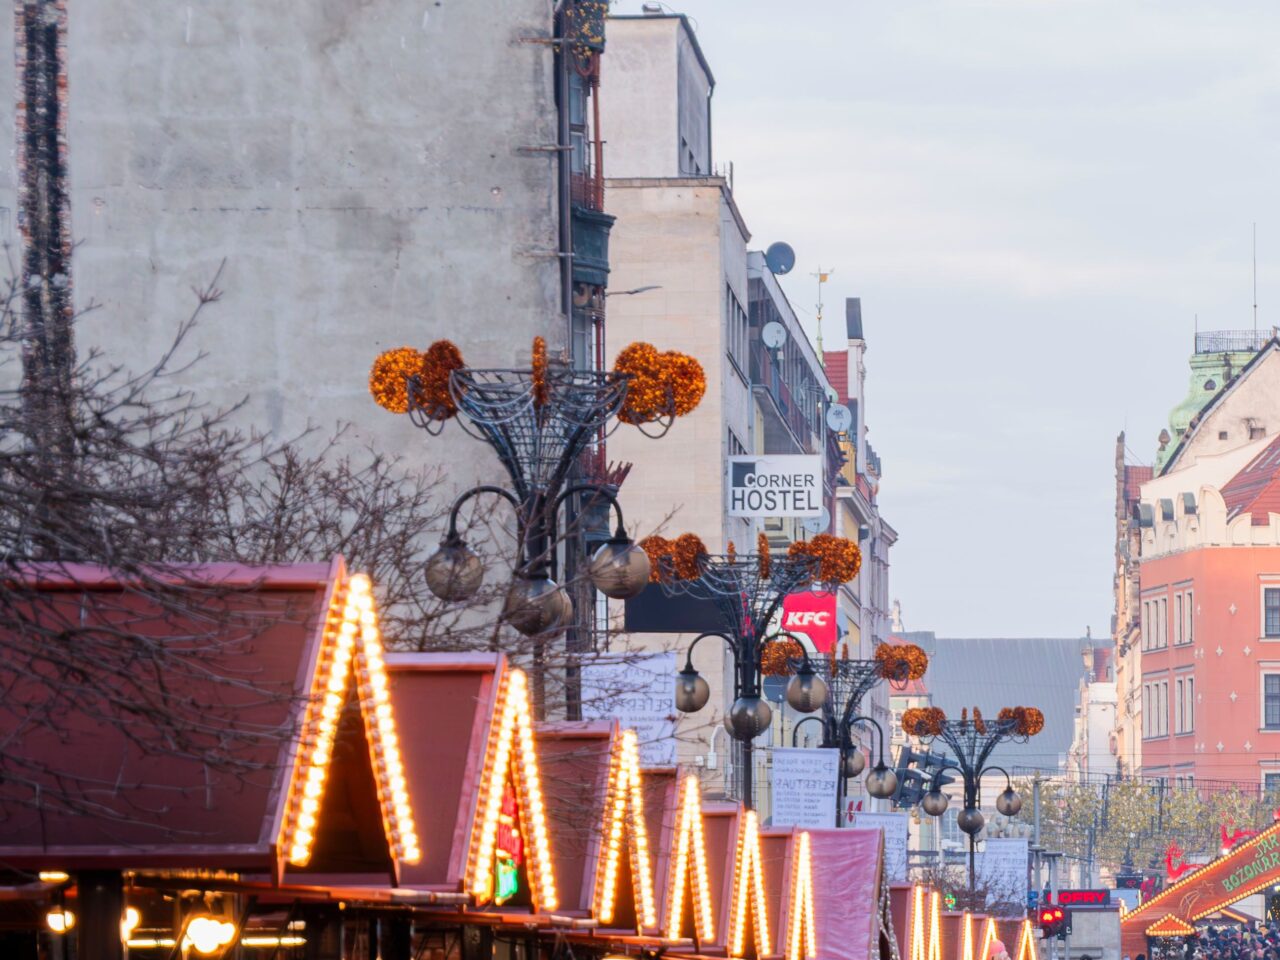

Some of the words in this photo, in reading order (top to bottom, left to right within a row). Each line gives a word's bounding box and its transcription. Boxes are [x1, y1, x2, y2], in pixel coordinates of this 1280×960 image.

[744, 473, 815, 488] CORNER
[731, 489, 819, 511] HOSTEL
[786, 612, 830, 626] KFC
